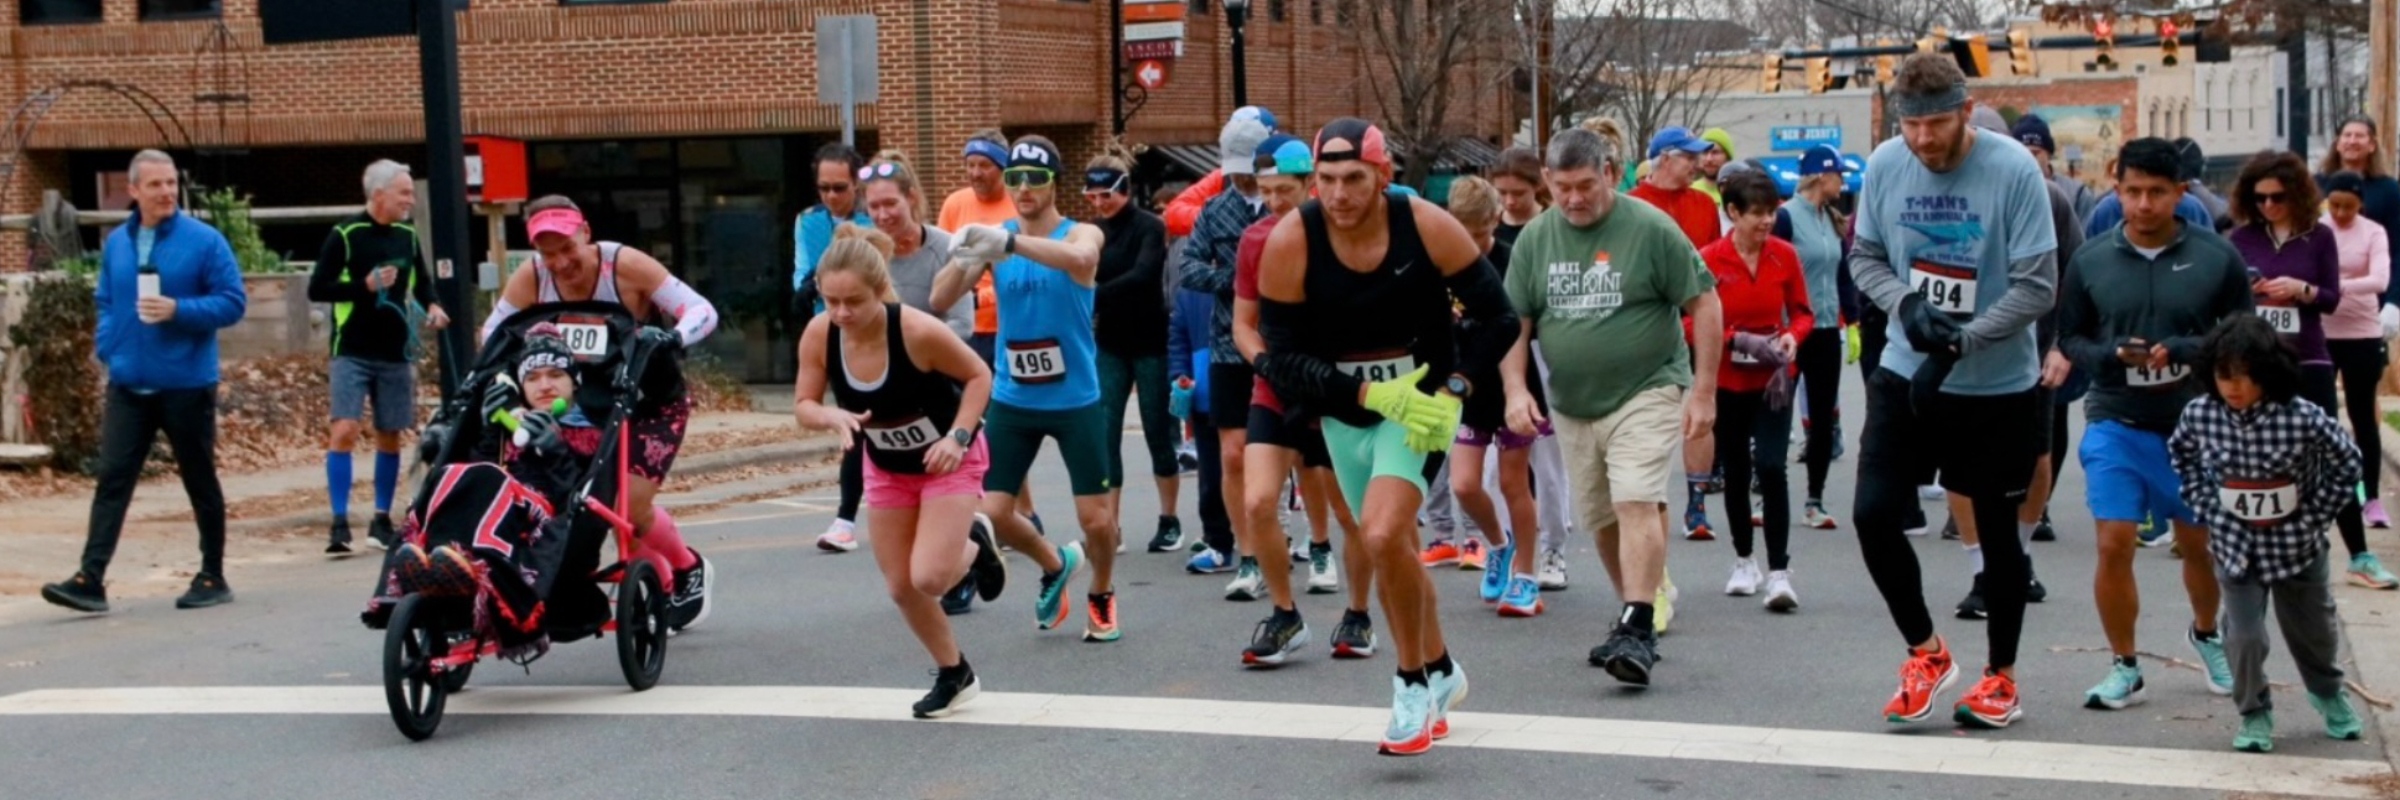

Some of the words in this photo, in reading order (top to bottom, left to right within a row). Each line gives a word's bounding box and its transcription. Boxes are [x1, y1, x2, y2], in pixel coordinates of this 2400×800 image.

[1905, 195, 1968, 211] T-MAN'S
[1547, 275, 1579, 295] HIGH
[1583, 271, 1622, 294] POINT
[1919, 276, 1962, 308] 494
[1015, 351, 1053, 374] 496
[881, 425, 926, 447] 490
[2234, 492, 2283, 516] 471
